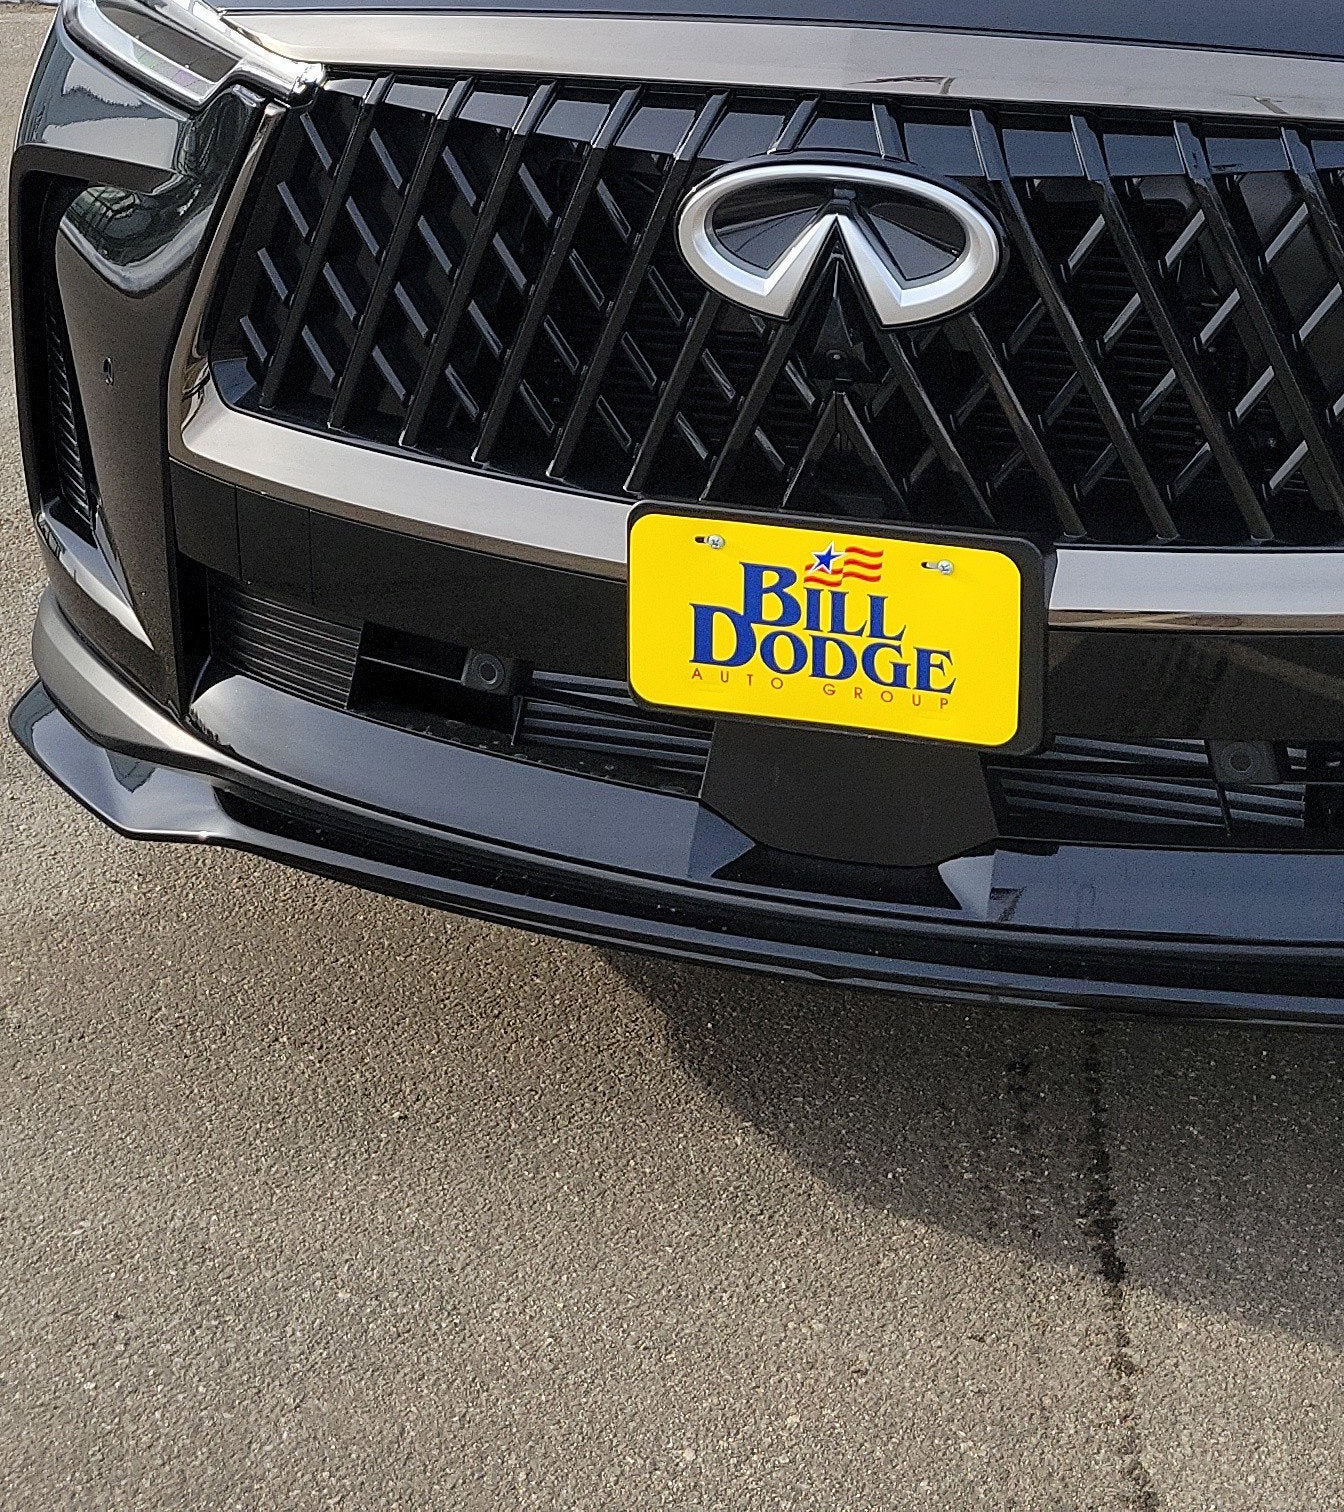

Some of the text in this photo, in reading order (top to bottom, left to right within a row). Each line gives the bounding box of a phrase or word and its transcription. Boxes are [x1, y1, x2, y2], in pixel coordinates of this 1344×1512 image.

[739, 561, 907, 641] BILL
[689, 602, 956, 694] DODGE
[692, 667, 949, 709] AUTO GROUP
